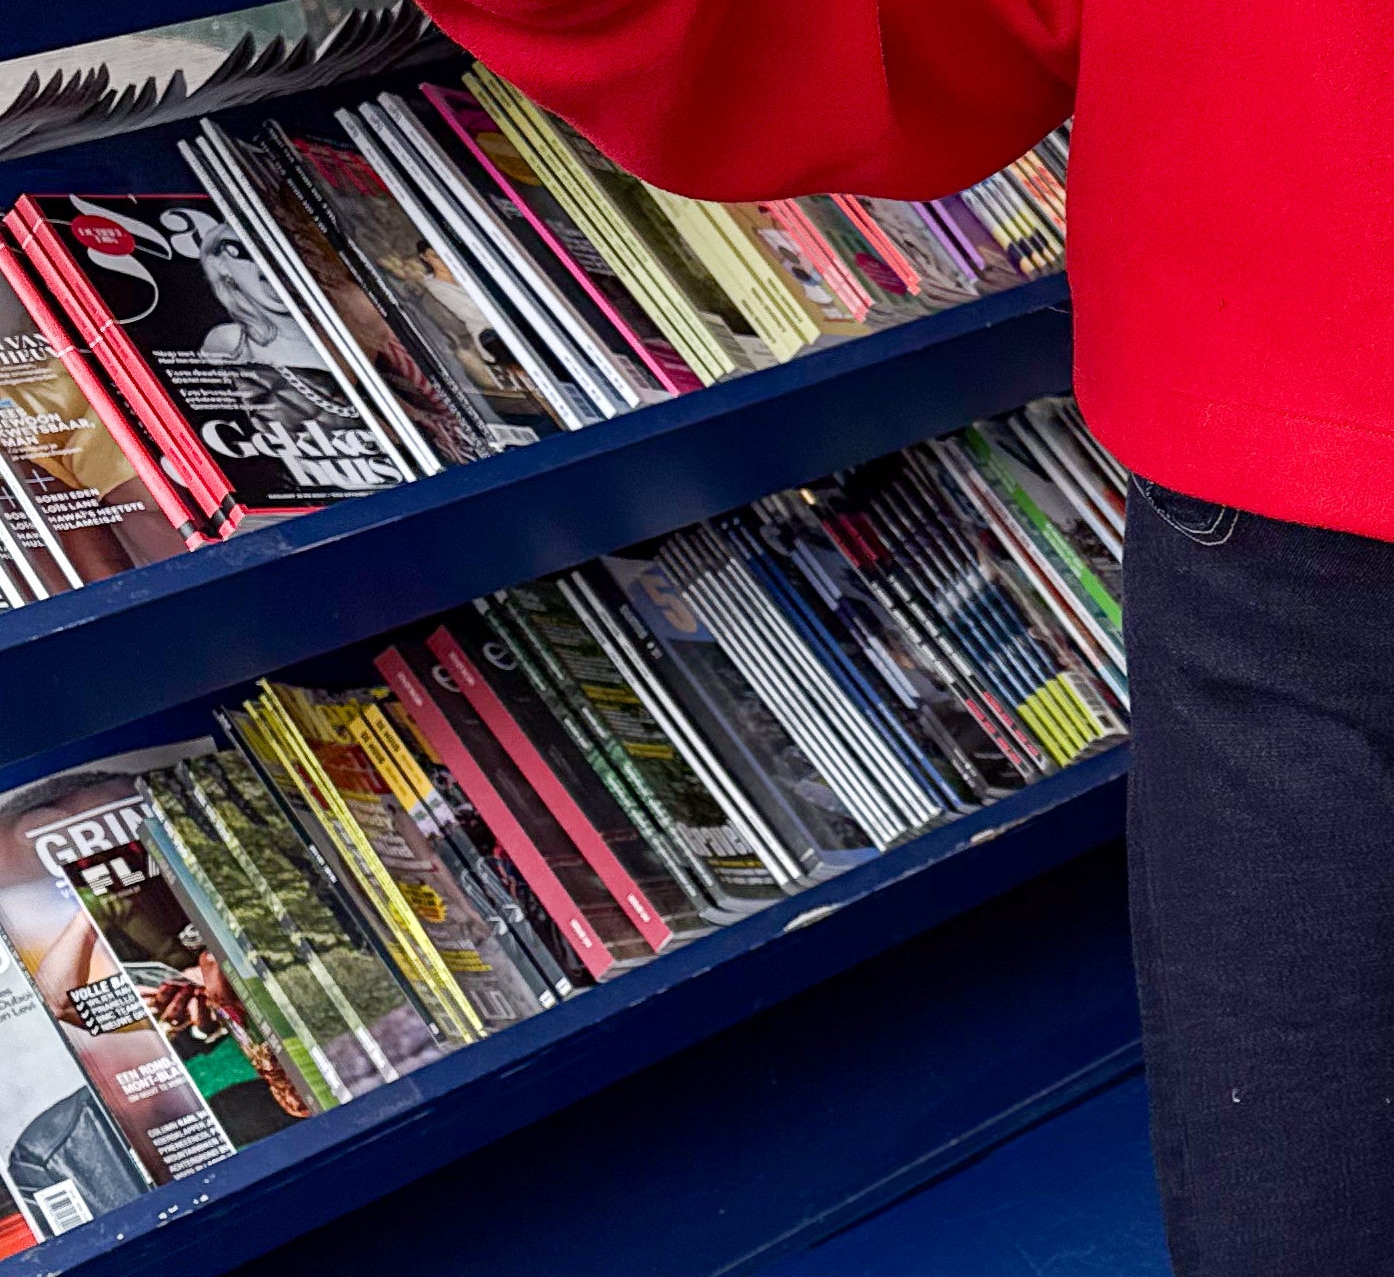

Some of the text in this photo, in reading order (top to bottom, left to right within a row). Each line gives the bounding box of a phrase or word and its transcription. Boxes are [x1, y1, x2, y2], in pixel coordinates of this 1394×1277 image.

[69, 487, 100, 500] EDEN
[68, 978, 111, 1004] VOLLE
[121, 1066, 182, 1095] MONT-BLA
